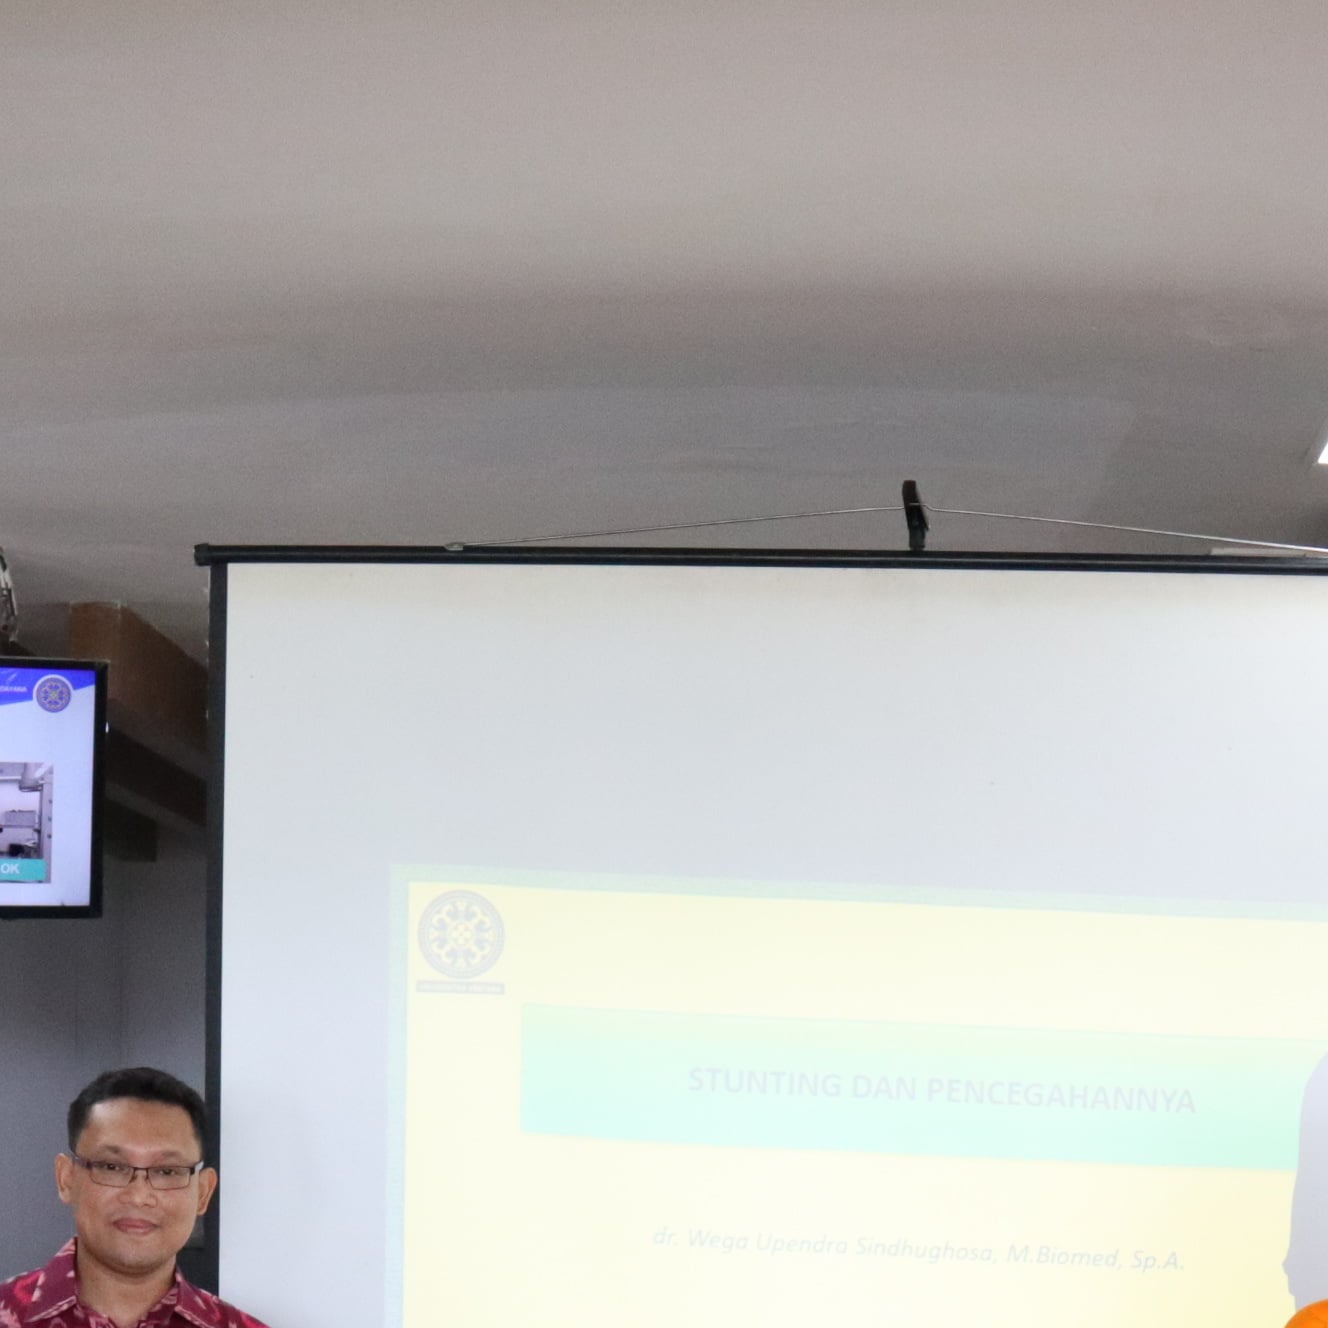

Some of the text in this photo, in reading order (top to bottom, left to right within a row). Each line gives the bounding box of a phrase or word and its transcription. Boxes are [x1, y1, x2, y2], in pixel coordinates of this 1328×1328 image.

[0, 863, 20, 874] OK
[688, 1065, 1197, 1115] STUNTING DAN PENCEGAHANNYA
[652, 1225, 1186, 1276] dr. Wega Upendra Sindhughosa, M.Biomed, Sp.A.
